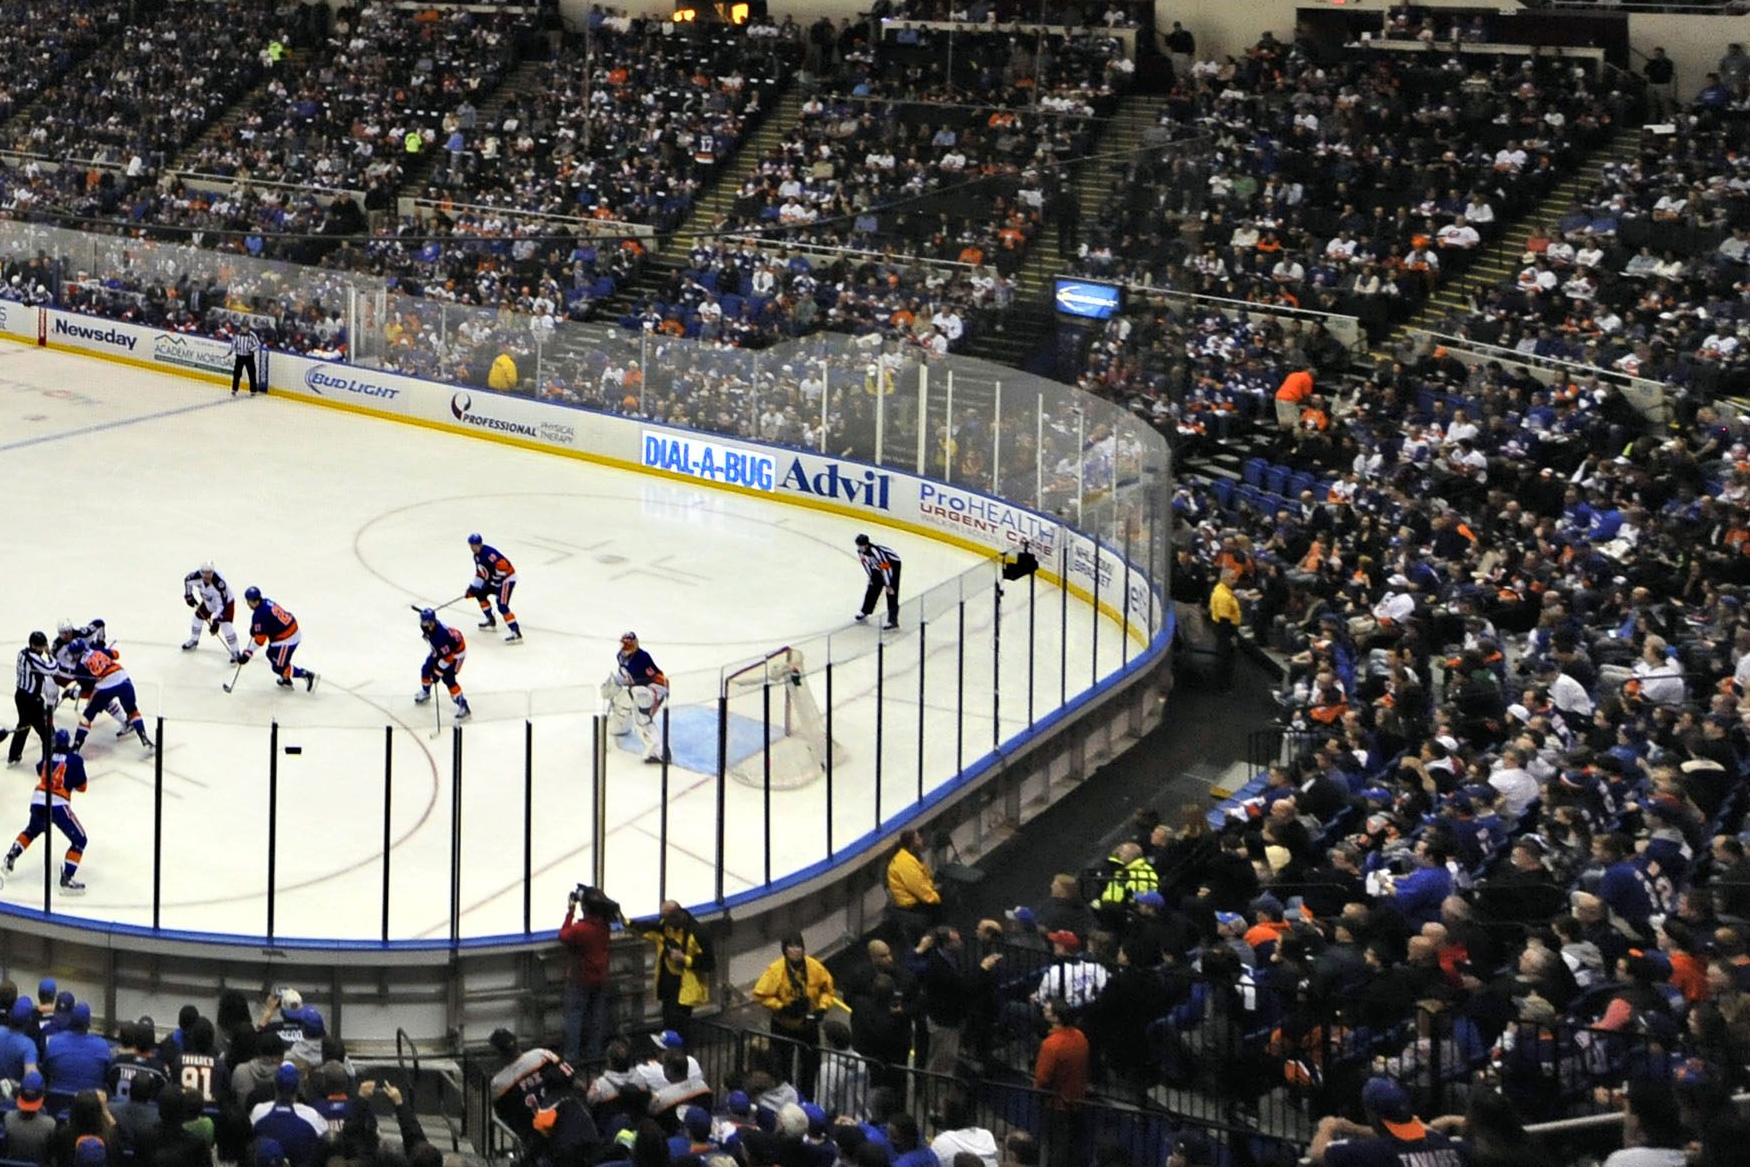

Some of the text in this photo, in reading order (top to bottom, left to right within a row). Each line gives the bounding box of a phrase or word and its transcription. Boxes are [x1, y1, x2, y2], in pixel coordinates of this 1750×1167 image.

[56, 319, 137, 350] Newsday
[155, 344, 194, 361] ACADEMY
[311, 373, 400, 400] BUD LIGHT
[463, 413, 537, 437] PROFESSIONAL
[540, 422, 575, 436] PHYSICAL
[540, 430, 574, 444] THERAPY
[645, 435, 772, 492] DIAL-A-BUG
[779, 456, 890, 511] Advil
[920, 483, 1057, 546] ProHEALTH
[920, 502, 999, 534] URGENT
[181, 1067, 214, 1102] 91
